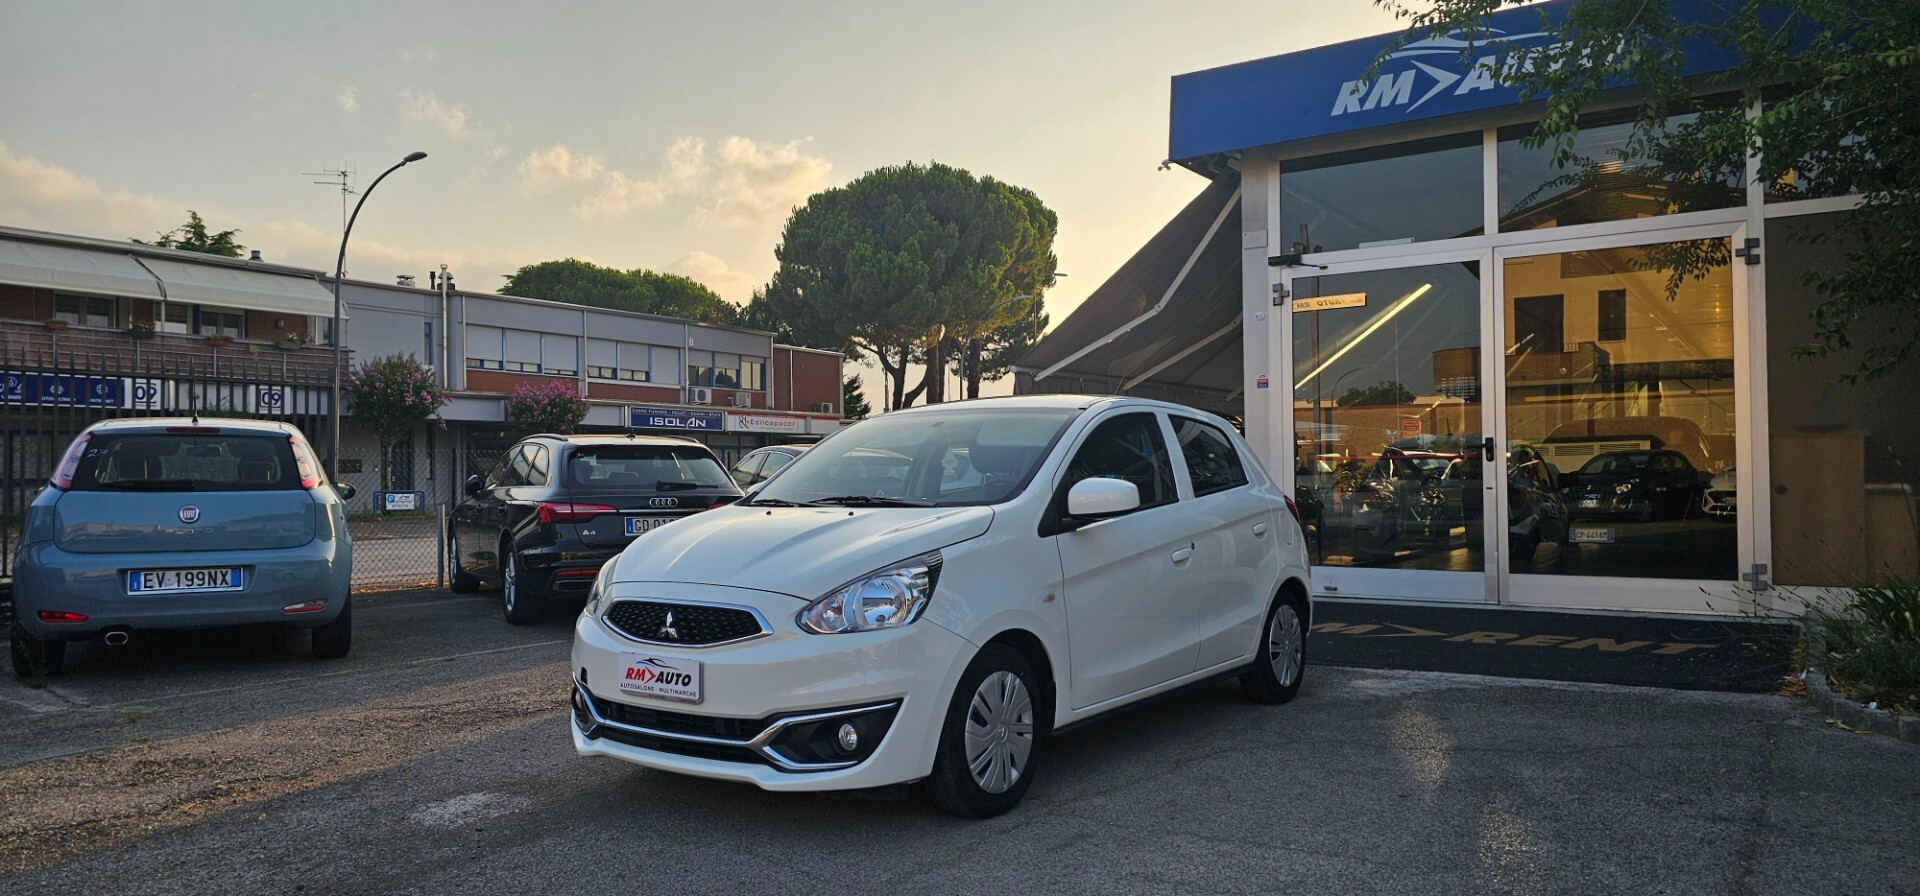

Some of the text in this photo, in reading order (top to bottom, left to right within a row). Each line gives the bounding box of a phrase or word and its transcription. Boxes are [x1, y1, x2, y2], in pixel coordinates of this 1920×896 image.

[1330, 69, 1416, 116] RM
[261, 391, 282, 406] 09
[649, 417, 706, 430] ISOLAN
[183, 510, 196, 519] FIAT
[634, 519, 650, 532] GD
[143, 570, 230, 589] EV 199NX
[1442, 631, 1721, 656] RENT
[625, 667, 692, 687] RM AUTO
[620, 682, 655, 692] AUTOSALONE
[659, 688, 697, 698] MULTIMARCHE
